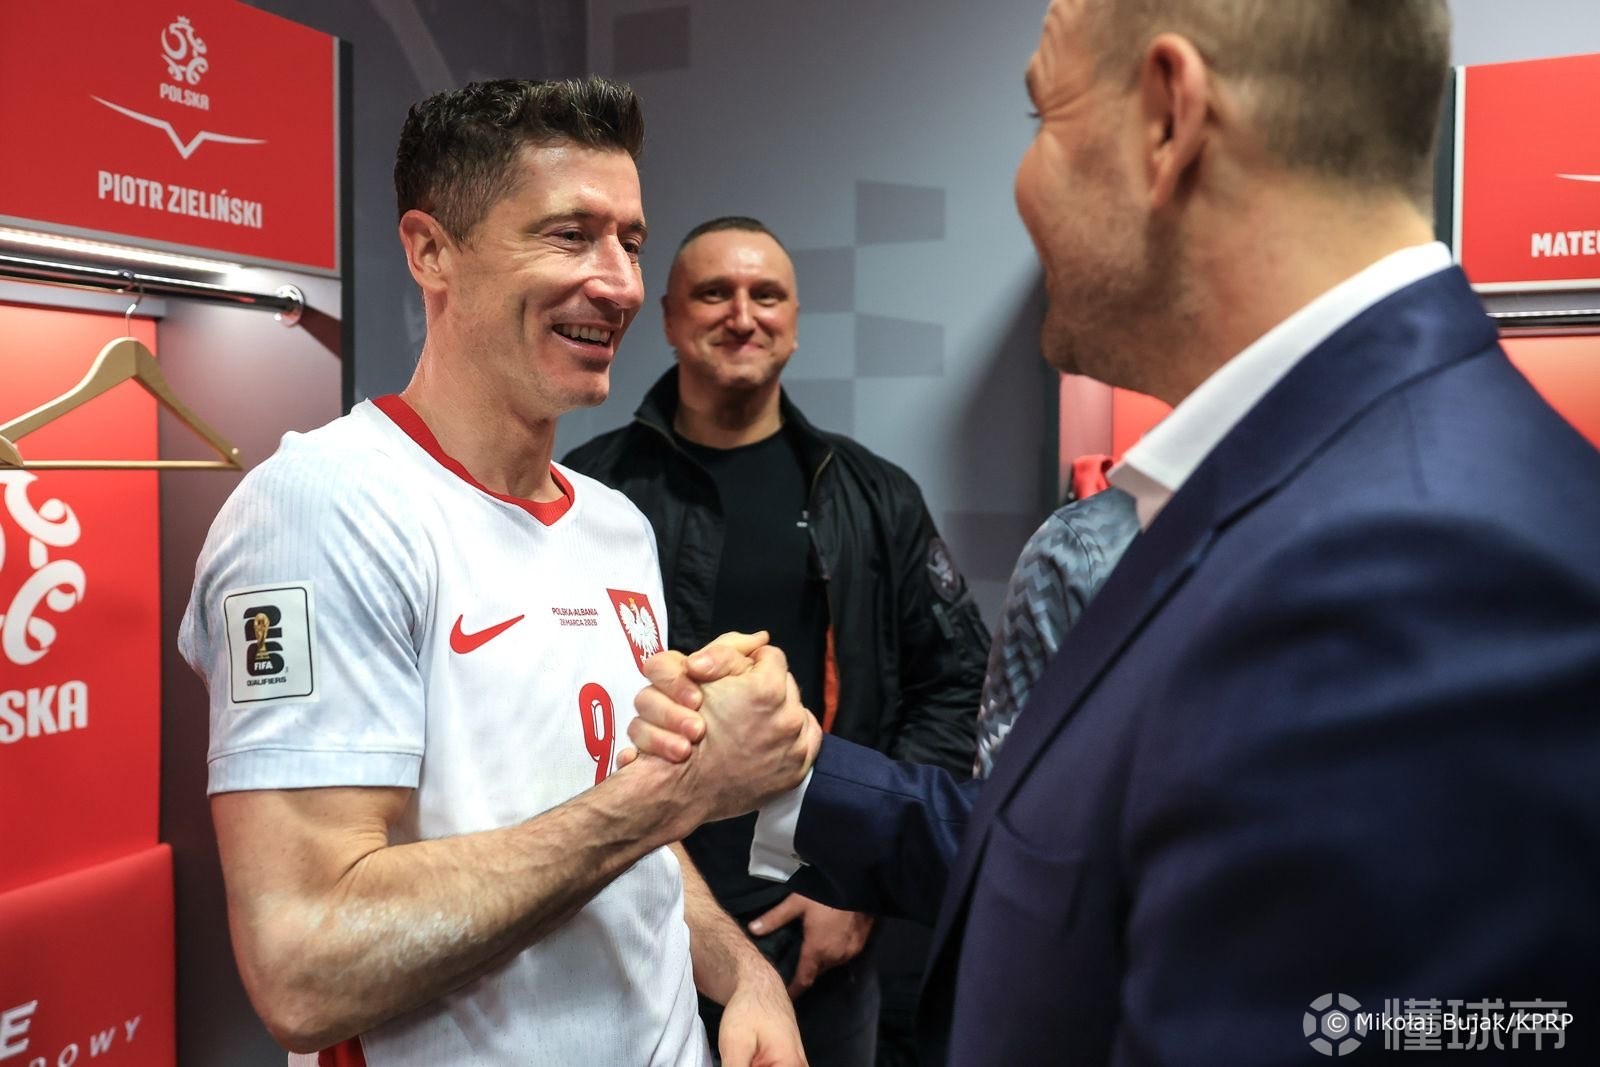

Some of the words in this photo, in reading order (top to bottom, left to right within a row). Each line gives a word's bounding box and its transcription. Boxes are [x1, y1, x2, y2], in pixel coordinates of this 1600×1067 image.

[160, 83, 209, 110] POLSKA
[98, 170, 163, 210] PIOTR
[168, 185, 262, 228] ZIELIŃSKI
[254, 660, 273, 671] FIFA
[246, 676, 287, 687] QUALIFIERS
[578, 682, 616, 786] 9
